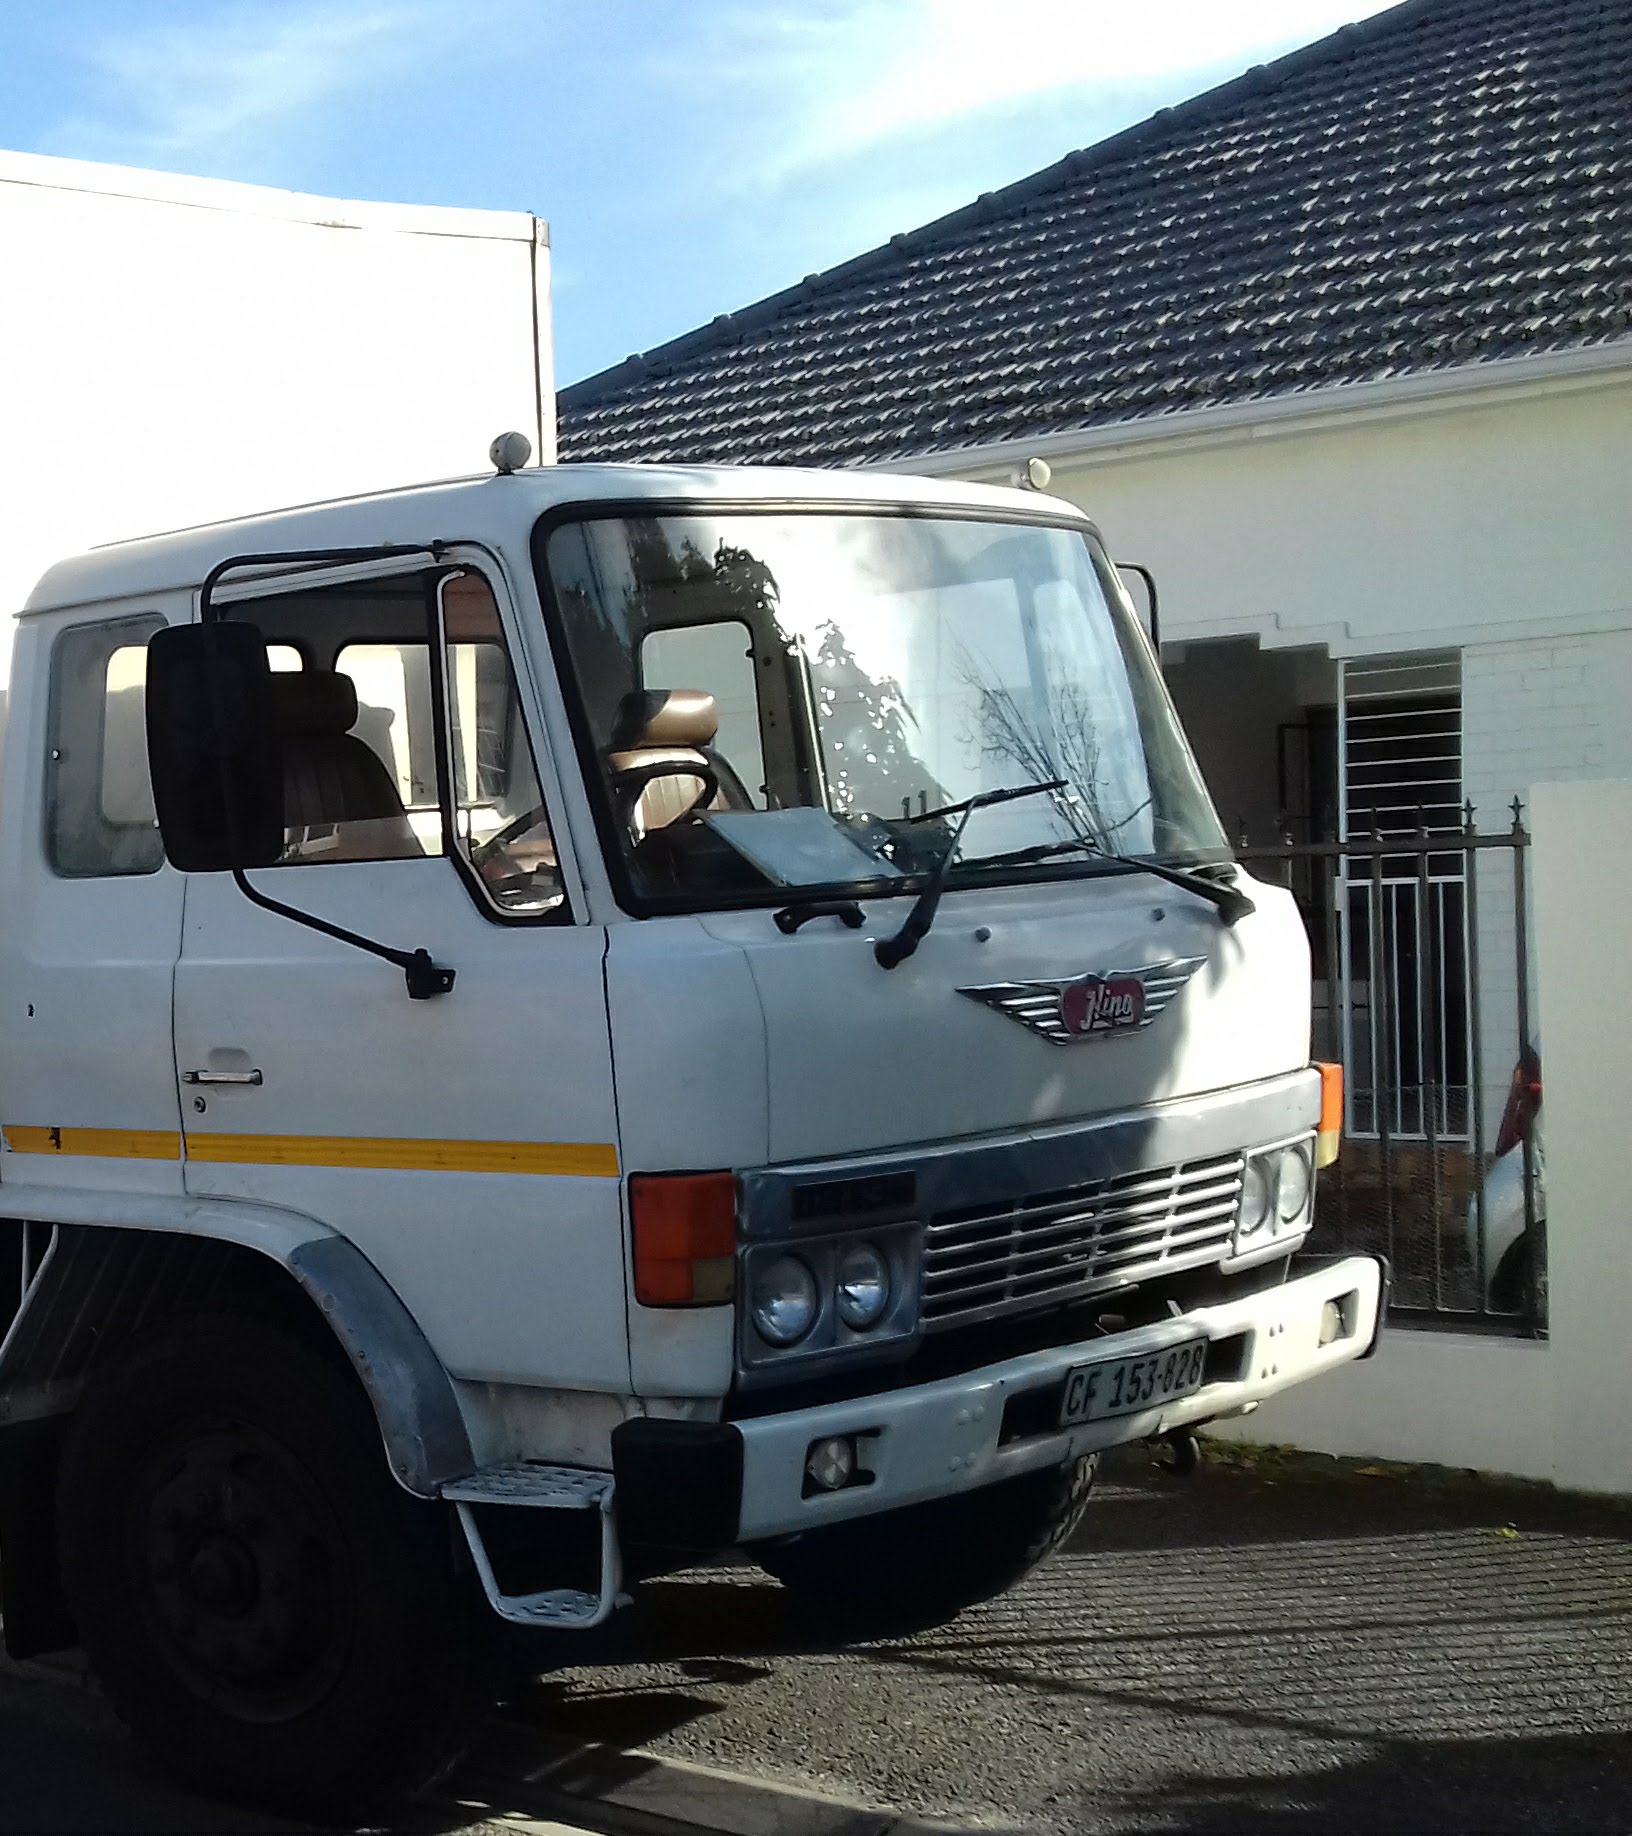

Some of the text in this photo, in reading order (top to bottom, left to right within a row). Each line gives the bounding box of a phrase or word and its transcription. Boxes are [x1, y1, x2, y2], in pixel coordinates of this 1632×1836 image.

[1080, 983, 1134, 1030] Hino
[1067, 1345, 1204, 1416] CF 153-828
